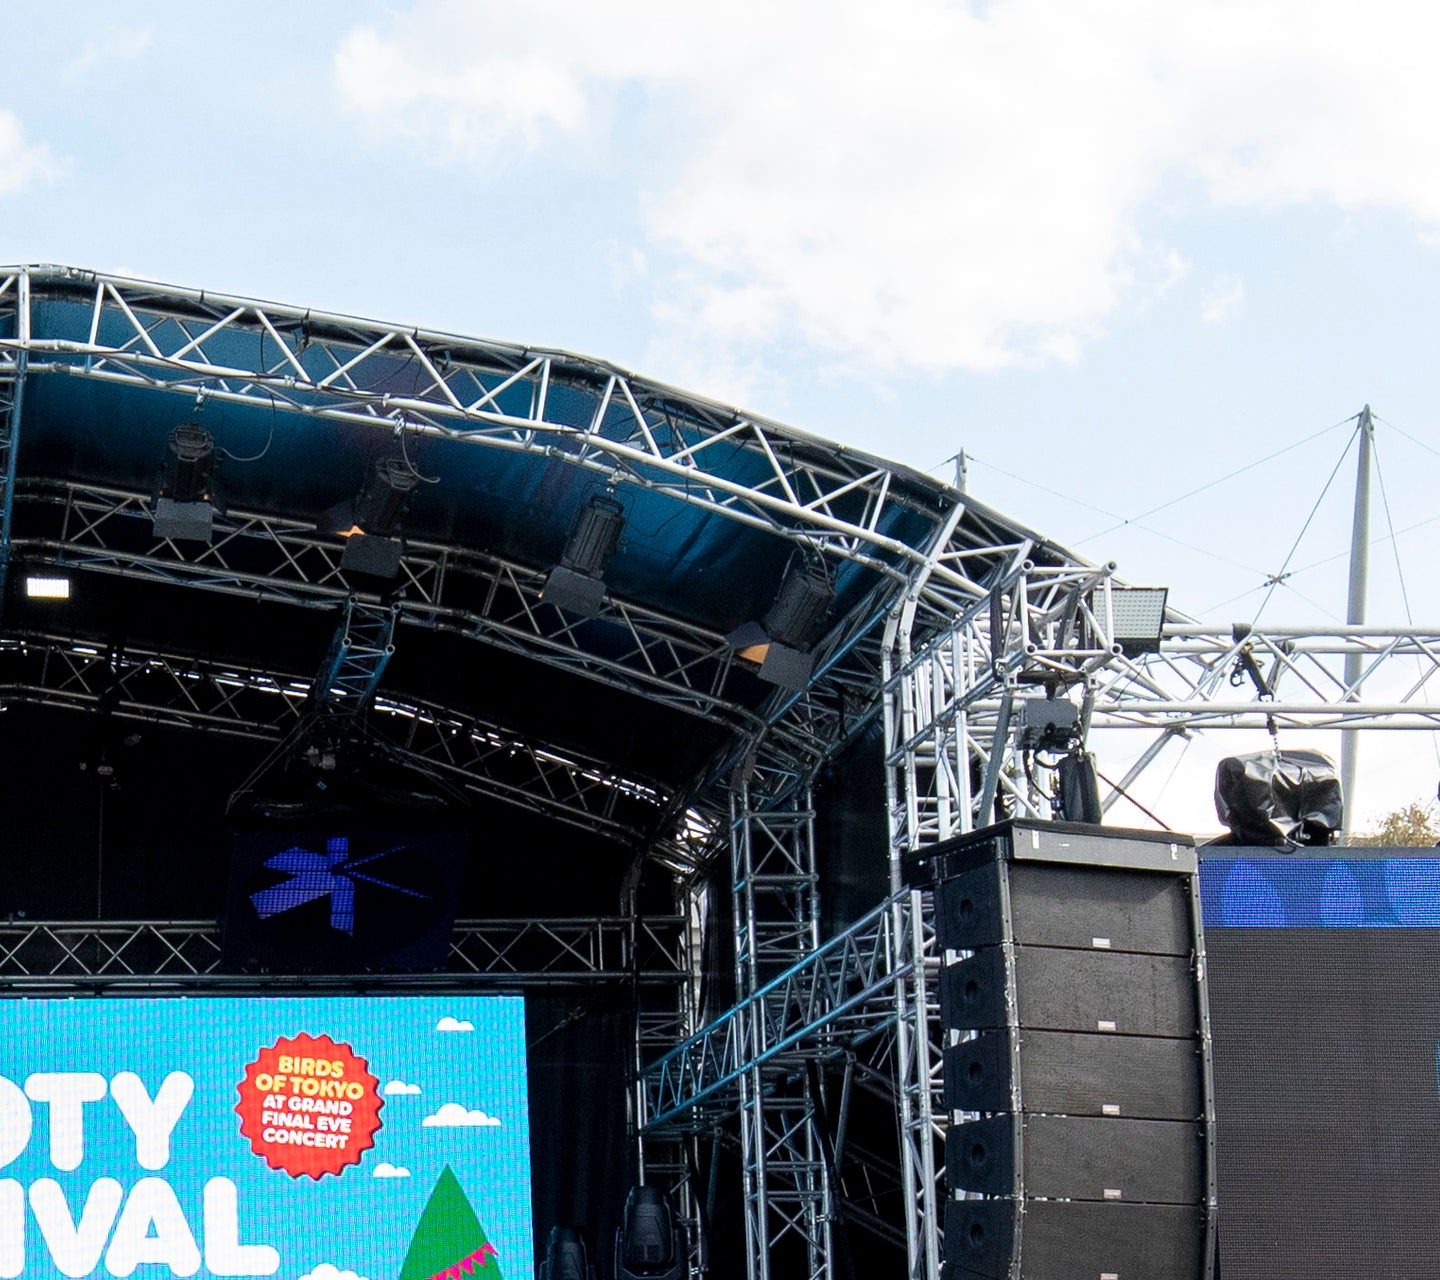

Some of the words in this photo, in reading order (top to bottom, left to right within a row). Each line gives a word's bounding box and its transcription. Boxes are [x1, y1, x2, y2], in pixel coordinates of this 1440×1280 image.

[278, 1055, 345, 1078] BIRDS
[255, 1073, 287, 1093] OF
[289, 1076, 364, 1100] TOKYO
[262, 1094, 287, 1109] AT
[288, 1096, 353, 1116] GRAND
[261, 1110, 314, 1130] FINAL
[317, 1116, 352, 1133] EVE
[262, 1128, 349, 1149] CONCERT
